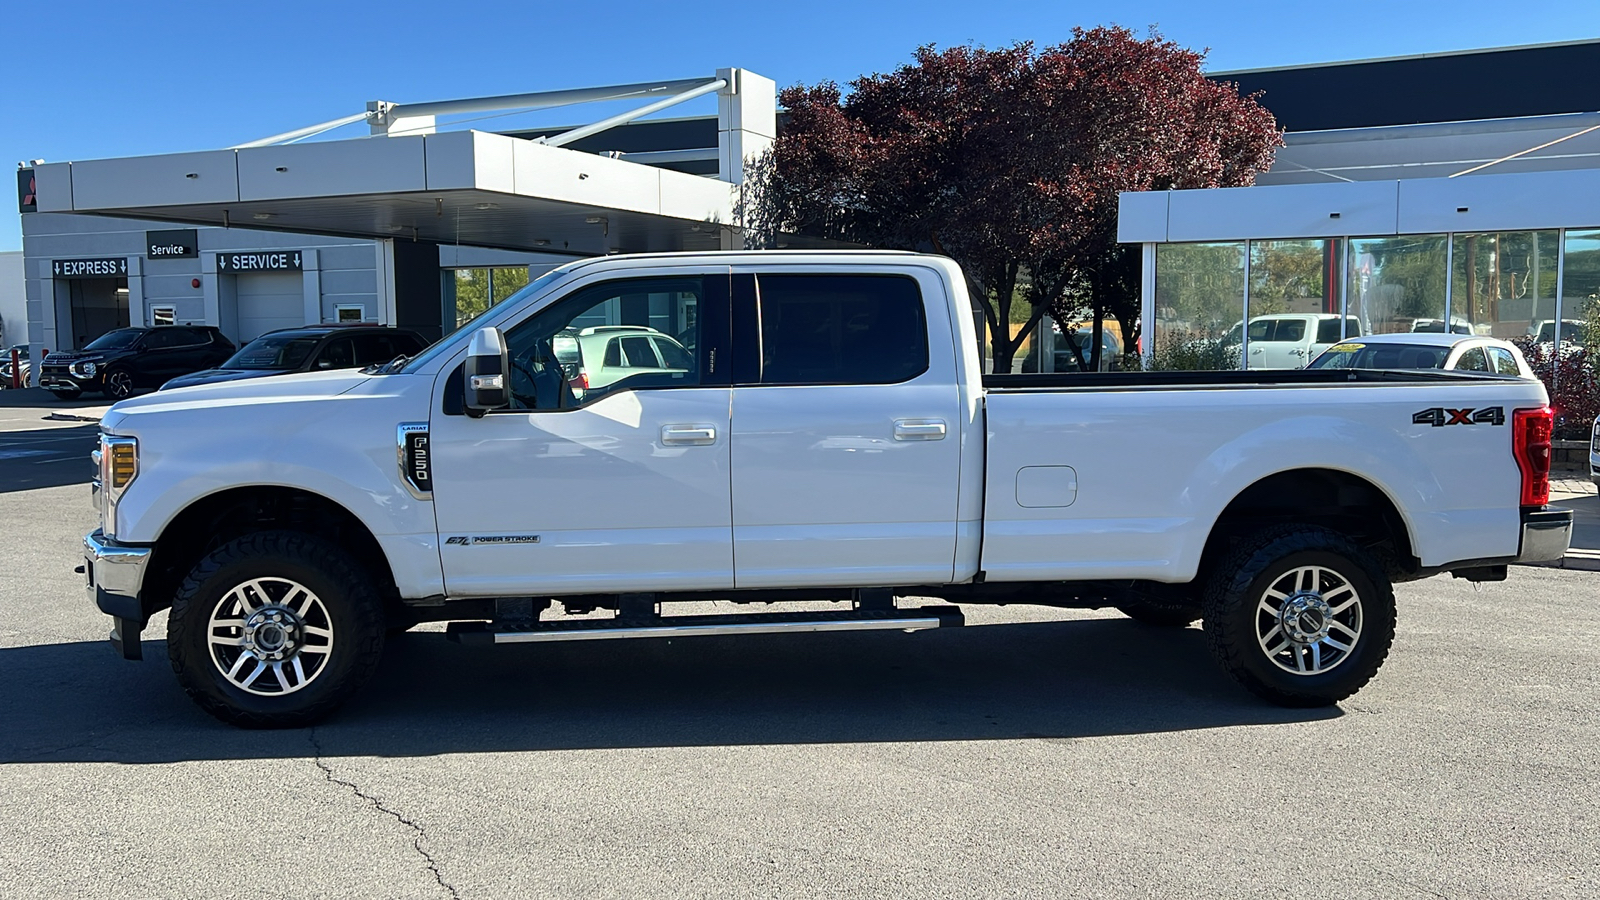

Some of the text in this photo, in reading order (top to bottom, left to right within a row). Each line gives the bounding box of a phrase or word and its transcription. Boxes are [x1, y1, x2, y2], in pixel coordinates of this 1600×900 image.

[151, 244, 184, 255] Service
[63, 260, 117, 275] EXPRESS
[232, 254, 288, 270] SERVICE
[474, 535, 503, 543] POWER
